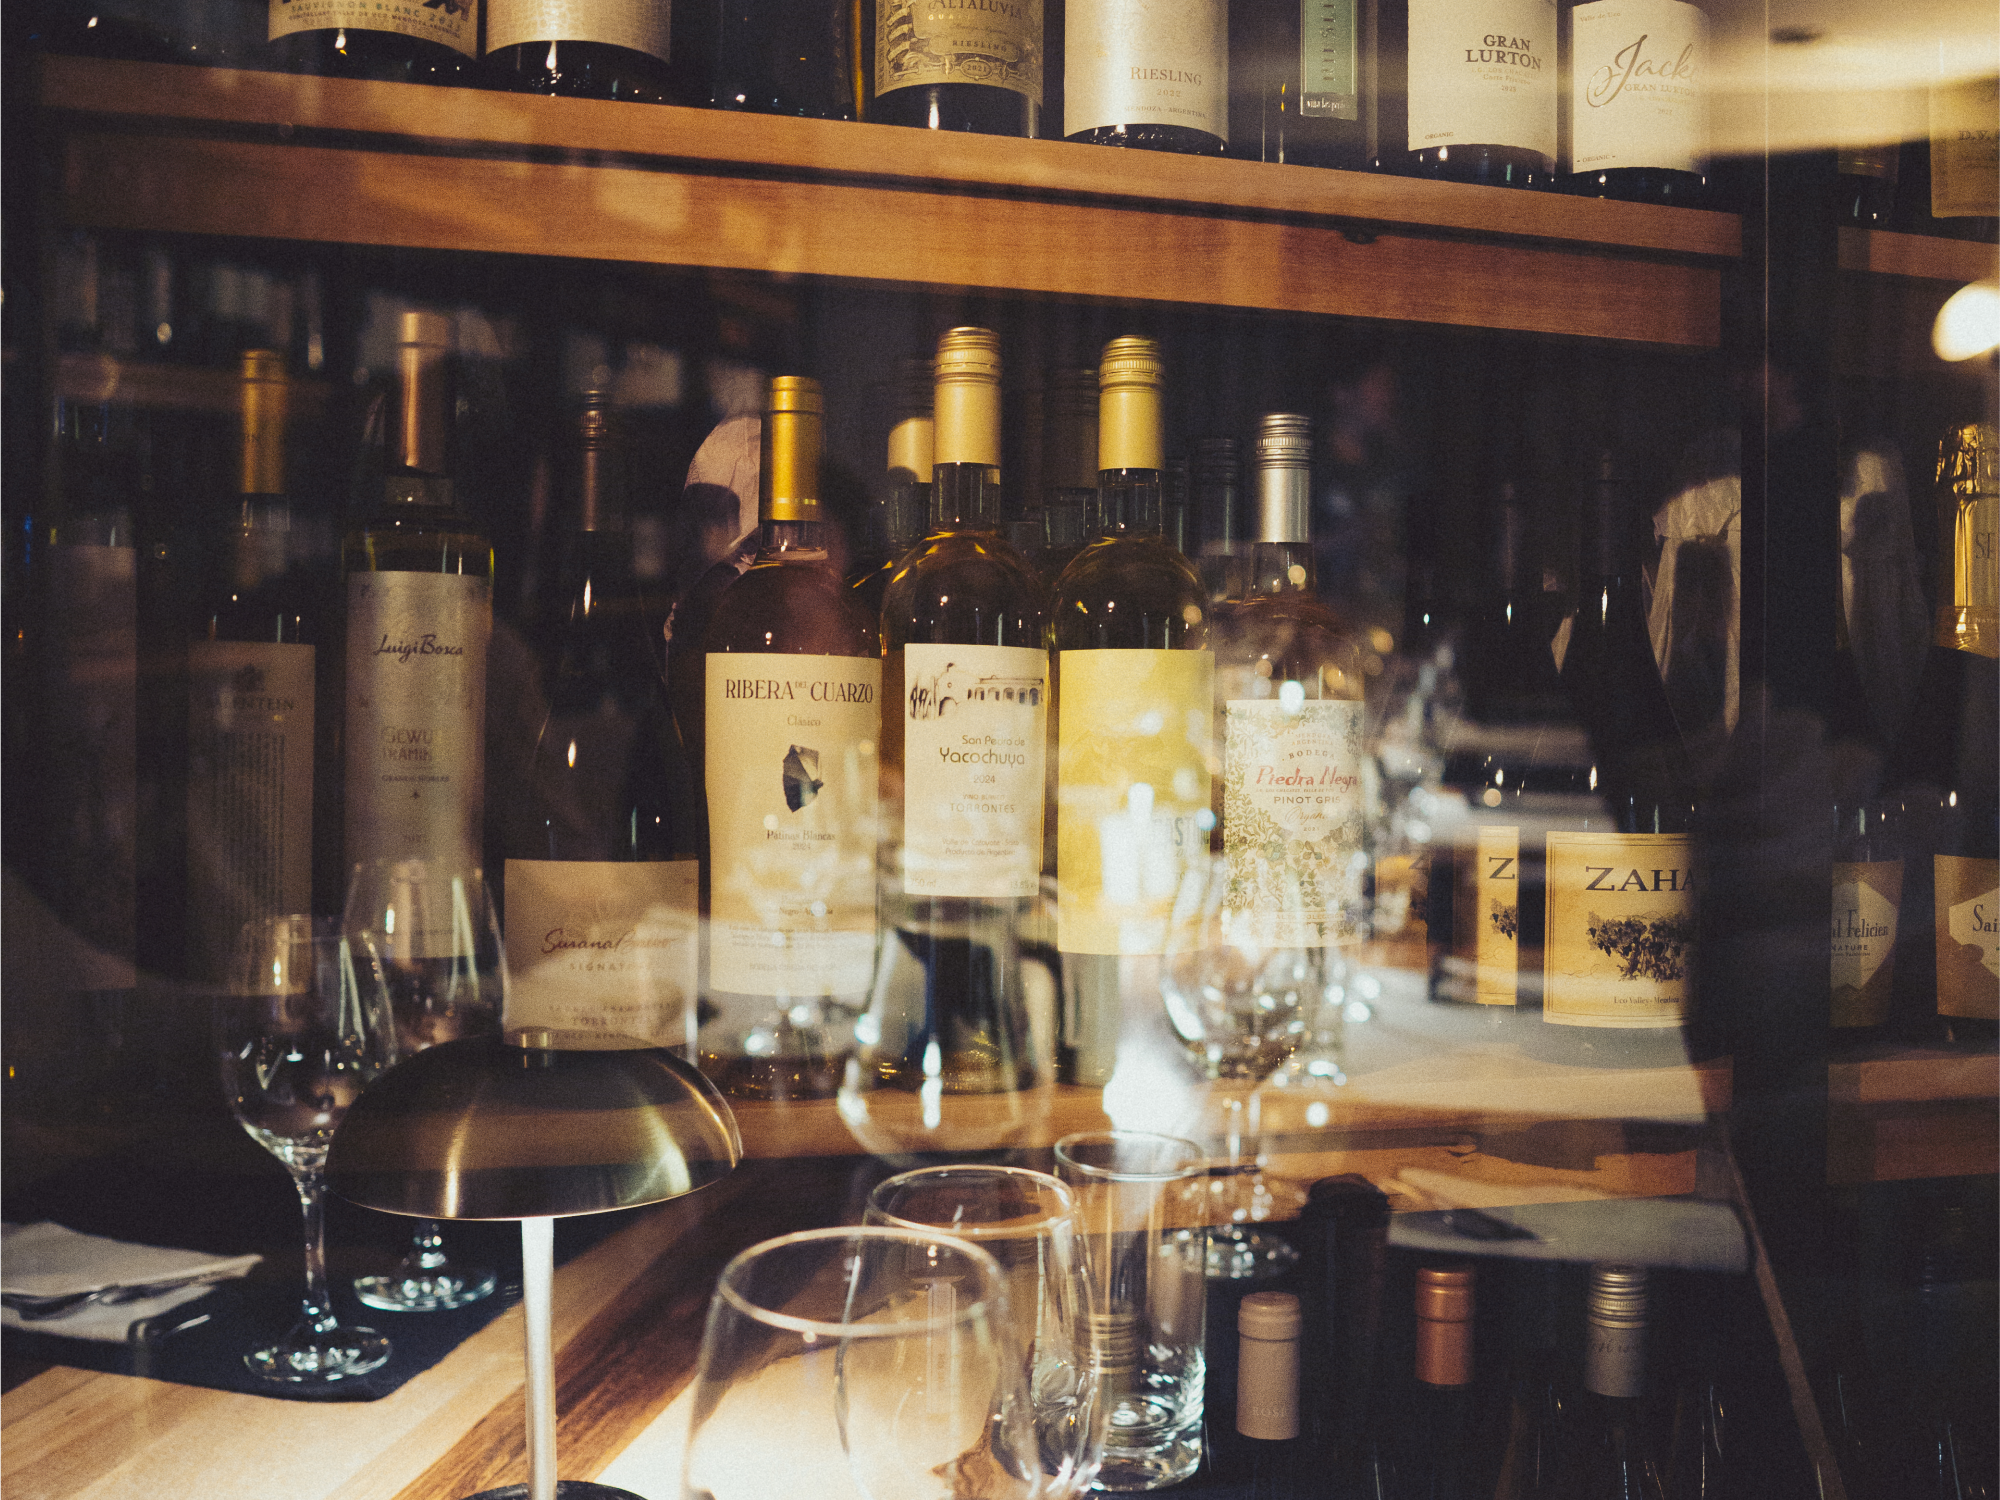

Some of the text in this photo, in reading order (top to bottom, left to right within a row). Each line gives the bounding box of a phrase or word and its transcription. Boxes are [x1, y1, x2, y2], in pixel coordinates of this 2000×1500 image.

[952, 40, 1007, 52] RIESLING
[1483, 34, 1531, 52] GRAN
[1465, 49, 1542, 72] LURTON
[1586, 34, 1695, 108] Jack
[1130, 66, 1202, 86] RIESLING
[1624, 83, 1656, 91] GRAN
[1424, 131, 1454, 140] ORGANIC
[373, 633, 463, 664] Luigi Bosca
[725, 679, 874, 704] RIBERA DEL CUARZO
[962, 735, 1026, 747] San Pedro de
[939, 746, 1026, 768] Yacochuya
[1288, 749, 1335, 760] BODEGA
[973, 775, 996, 784] 2024
[1256, 764, 1315, 787] Piedra
[1273, 796, 1312, 805] PINOT
[1585, 865, 1695, 892] ZAHA
[1846, 908, 1889, 938] Felicien
[541, 928, 615, 954] Susana
